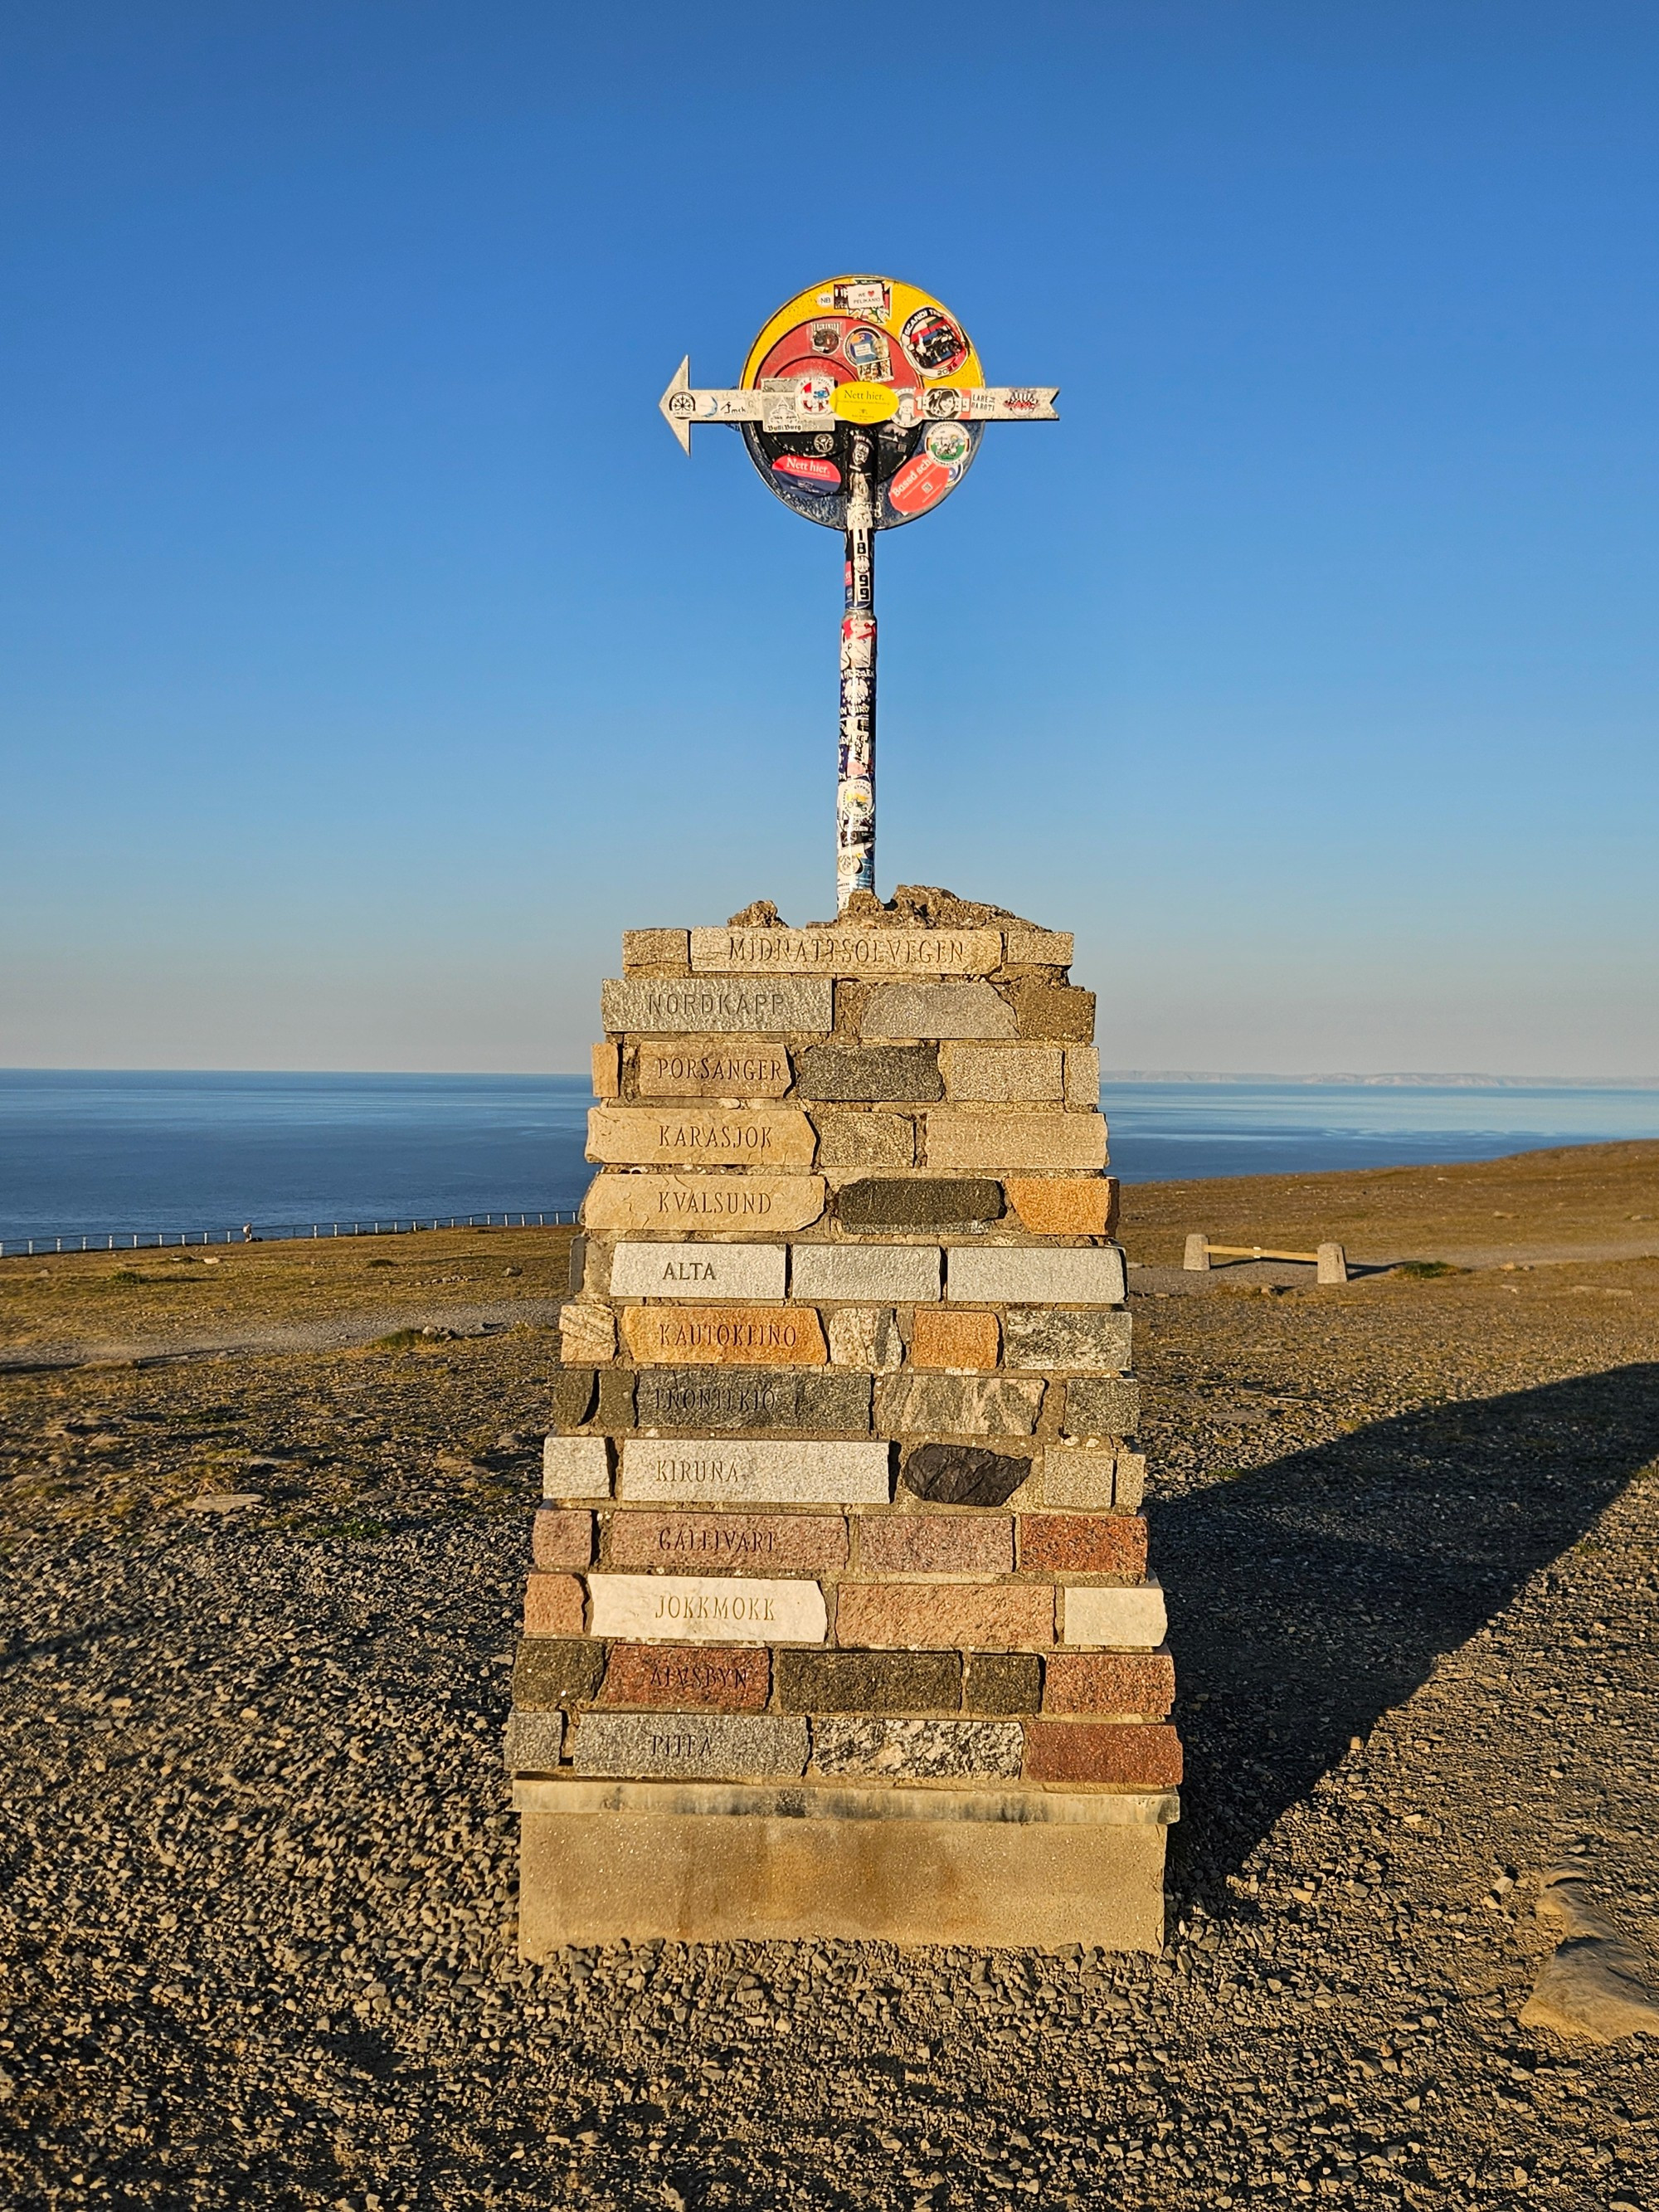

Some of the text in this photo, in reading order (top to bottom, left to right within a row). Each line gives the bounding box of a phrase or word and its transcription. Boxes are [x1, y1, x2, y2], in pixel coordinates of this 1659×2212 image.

[904, 309, 927, 335] SCANDI
[844, 389, 884, 401] Nett hier.
[786, 456, 808, 470] Nett
[892, 470, 918, 498] Bassd
[649, 993, 786, 1016] NORDKAPP
[658, 1057, 784, 1081] PORSANGER
[659, 1124, 772, 1149] KARASJOK
[659, 1191, 772, 1215] KVALSUND
[662, 1262, 718, 1281] ALTA
[659, 1323, 797, 1347] KAUTOKEINO
[656, 1459, 738, 1483] KIRUNA
[654, 1595, 776, 1621] JOKKMOKK
